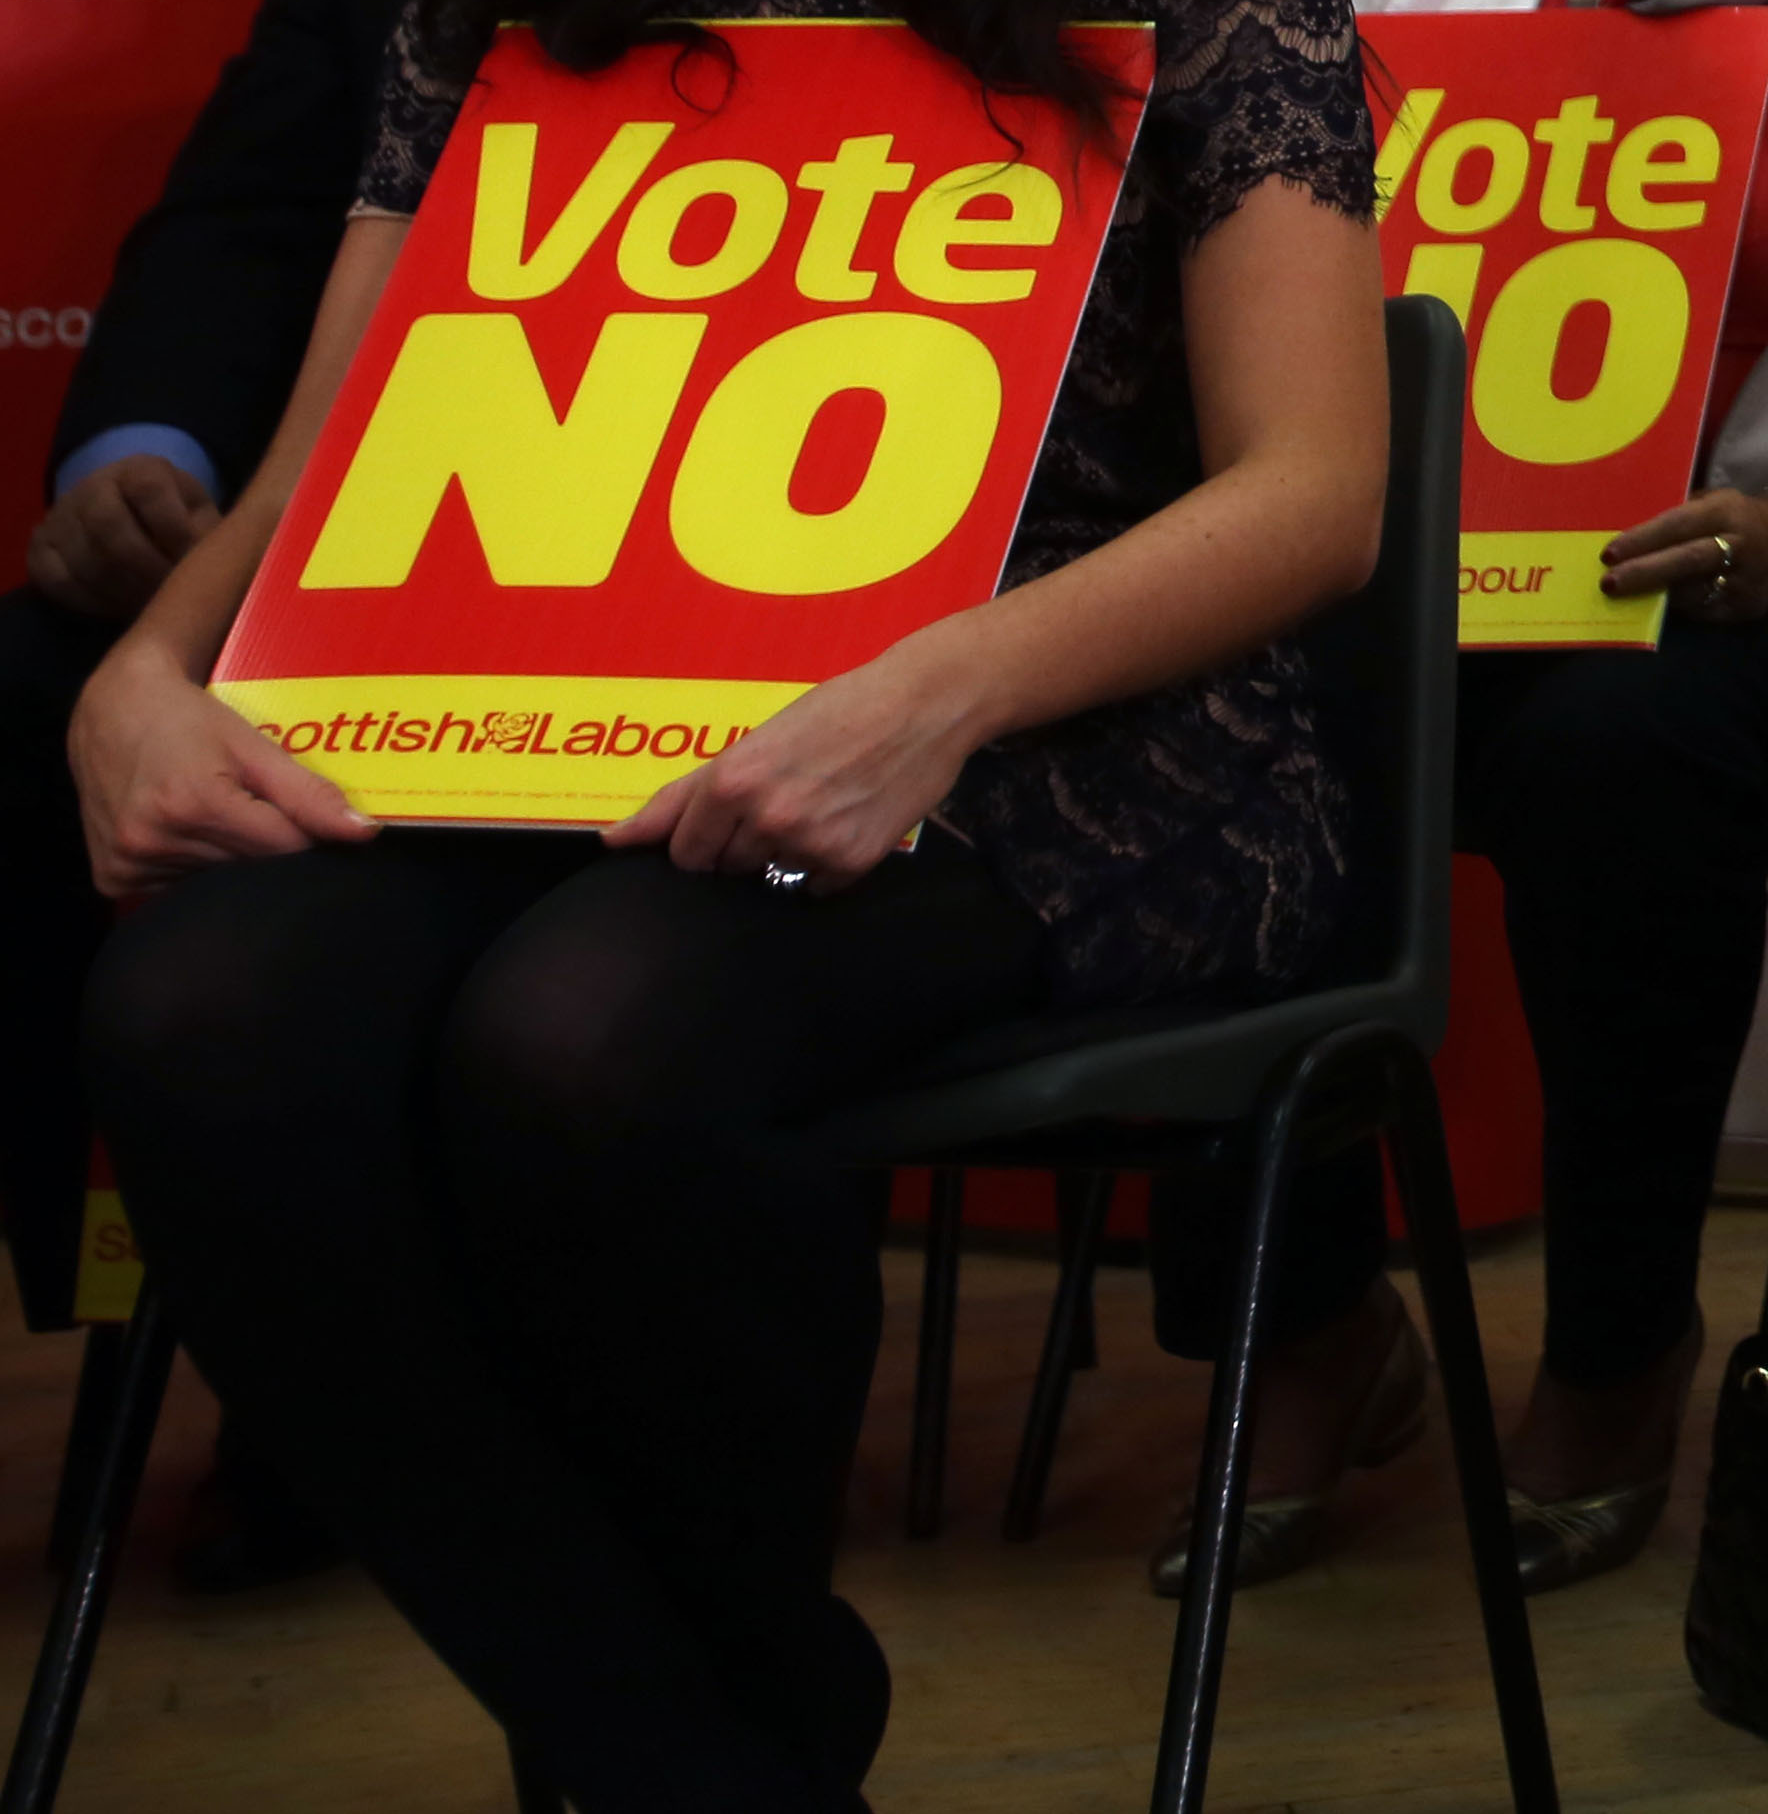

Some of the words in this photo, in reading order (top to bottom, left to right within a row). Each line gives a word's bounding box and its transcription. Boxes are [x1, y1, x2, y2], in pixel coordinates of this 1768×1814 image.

[467, 121, 1062, 304] Vote
[297, 311, 1002, 595] NO
[528, 712, 750, 759] Labou
